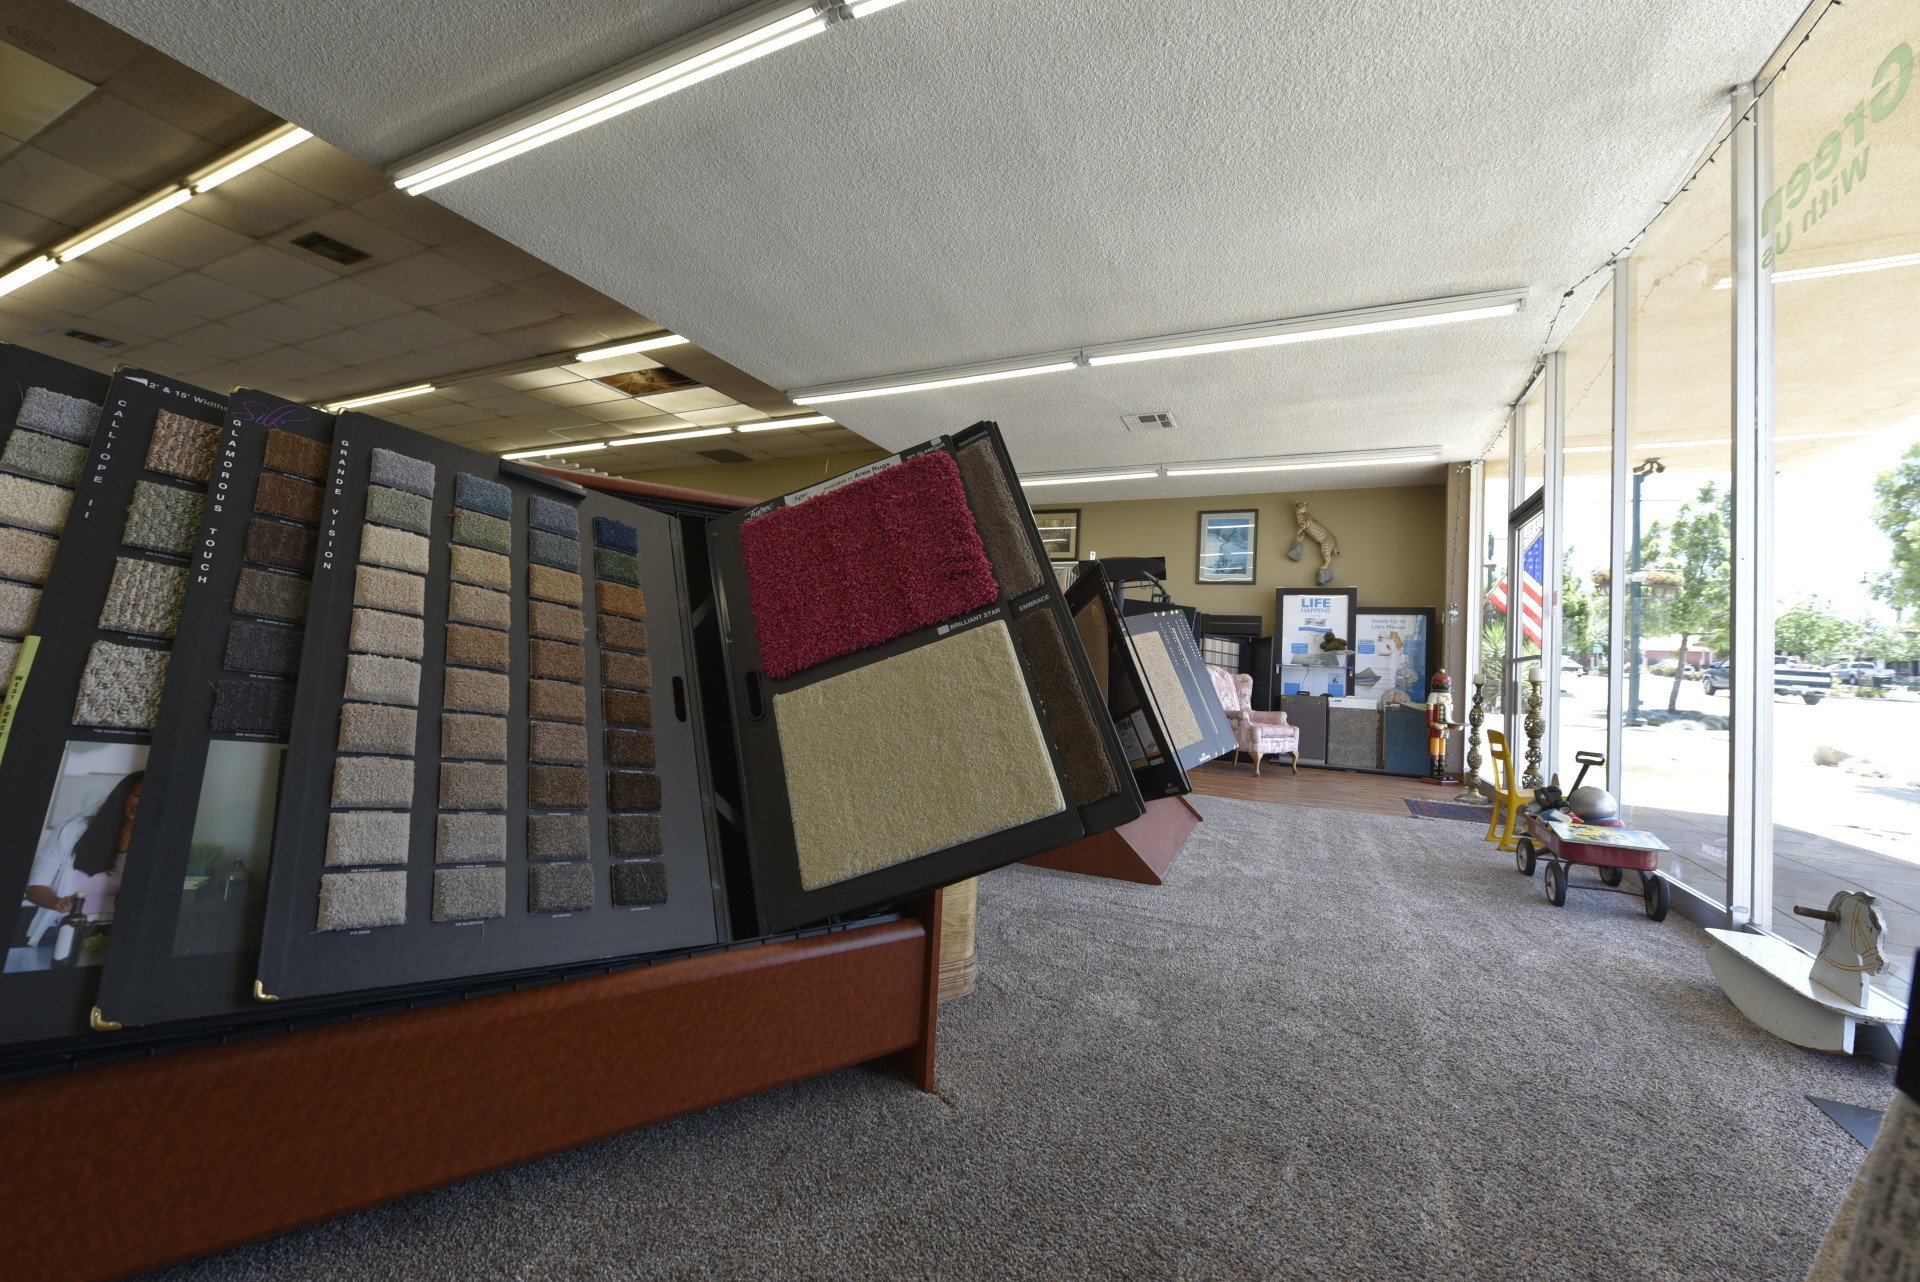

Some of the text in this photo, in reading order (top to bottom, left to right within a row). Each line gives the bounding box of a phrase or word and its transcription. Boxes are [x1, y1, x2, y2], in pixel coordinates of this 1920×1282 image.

[175, 390, 190, 399] 15'
[194, 395, 228, 411] Widths
[94, 400, 127, 484] CALLIOPE
[854, 468, 871, 479] Area
[872, 461, 891, 474] Rugs
[198, 419, 242, 584] GLAMOROUS TOUCH
[323, 440, 349, 569] GRANDE VISION
[1018, 594, 1050, 611] EMBRACE
[1301, 598, 1331, 608] LIFE
[949, 607, 1001, 630] BRILLIANT STAR
